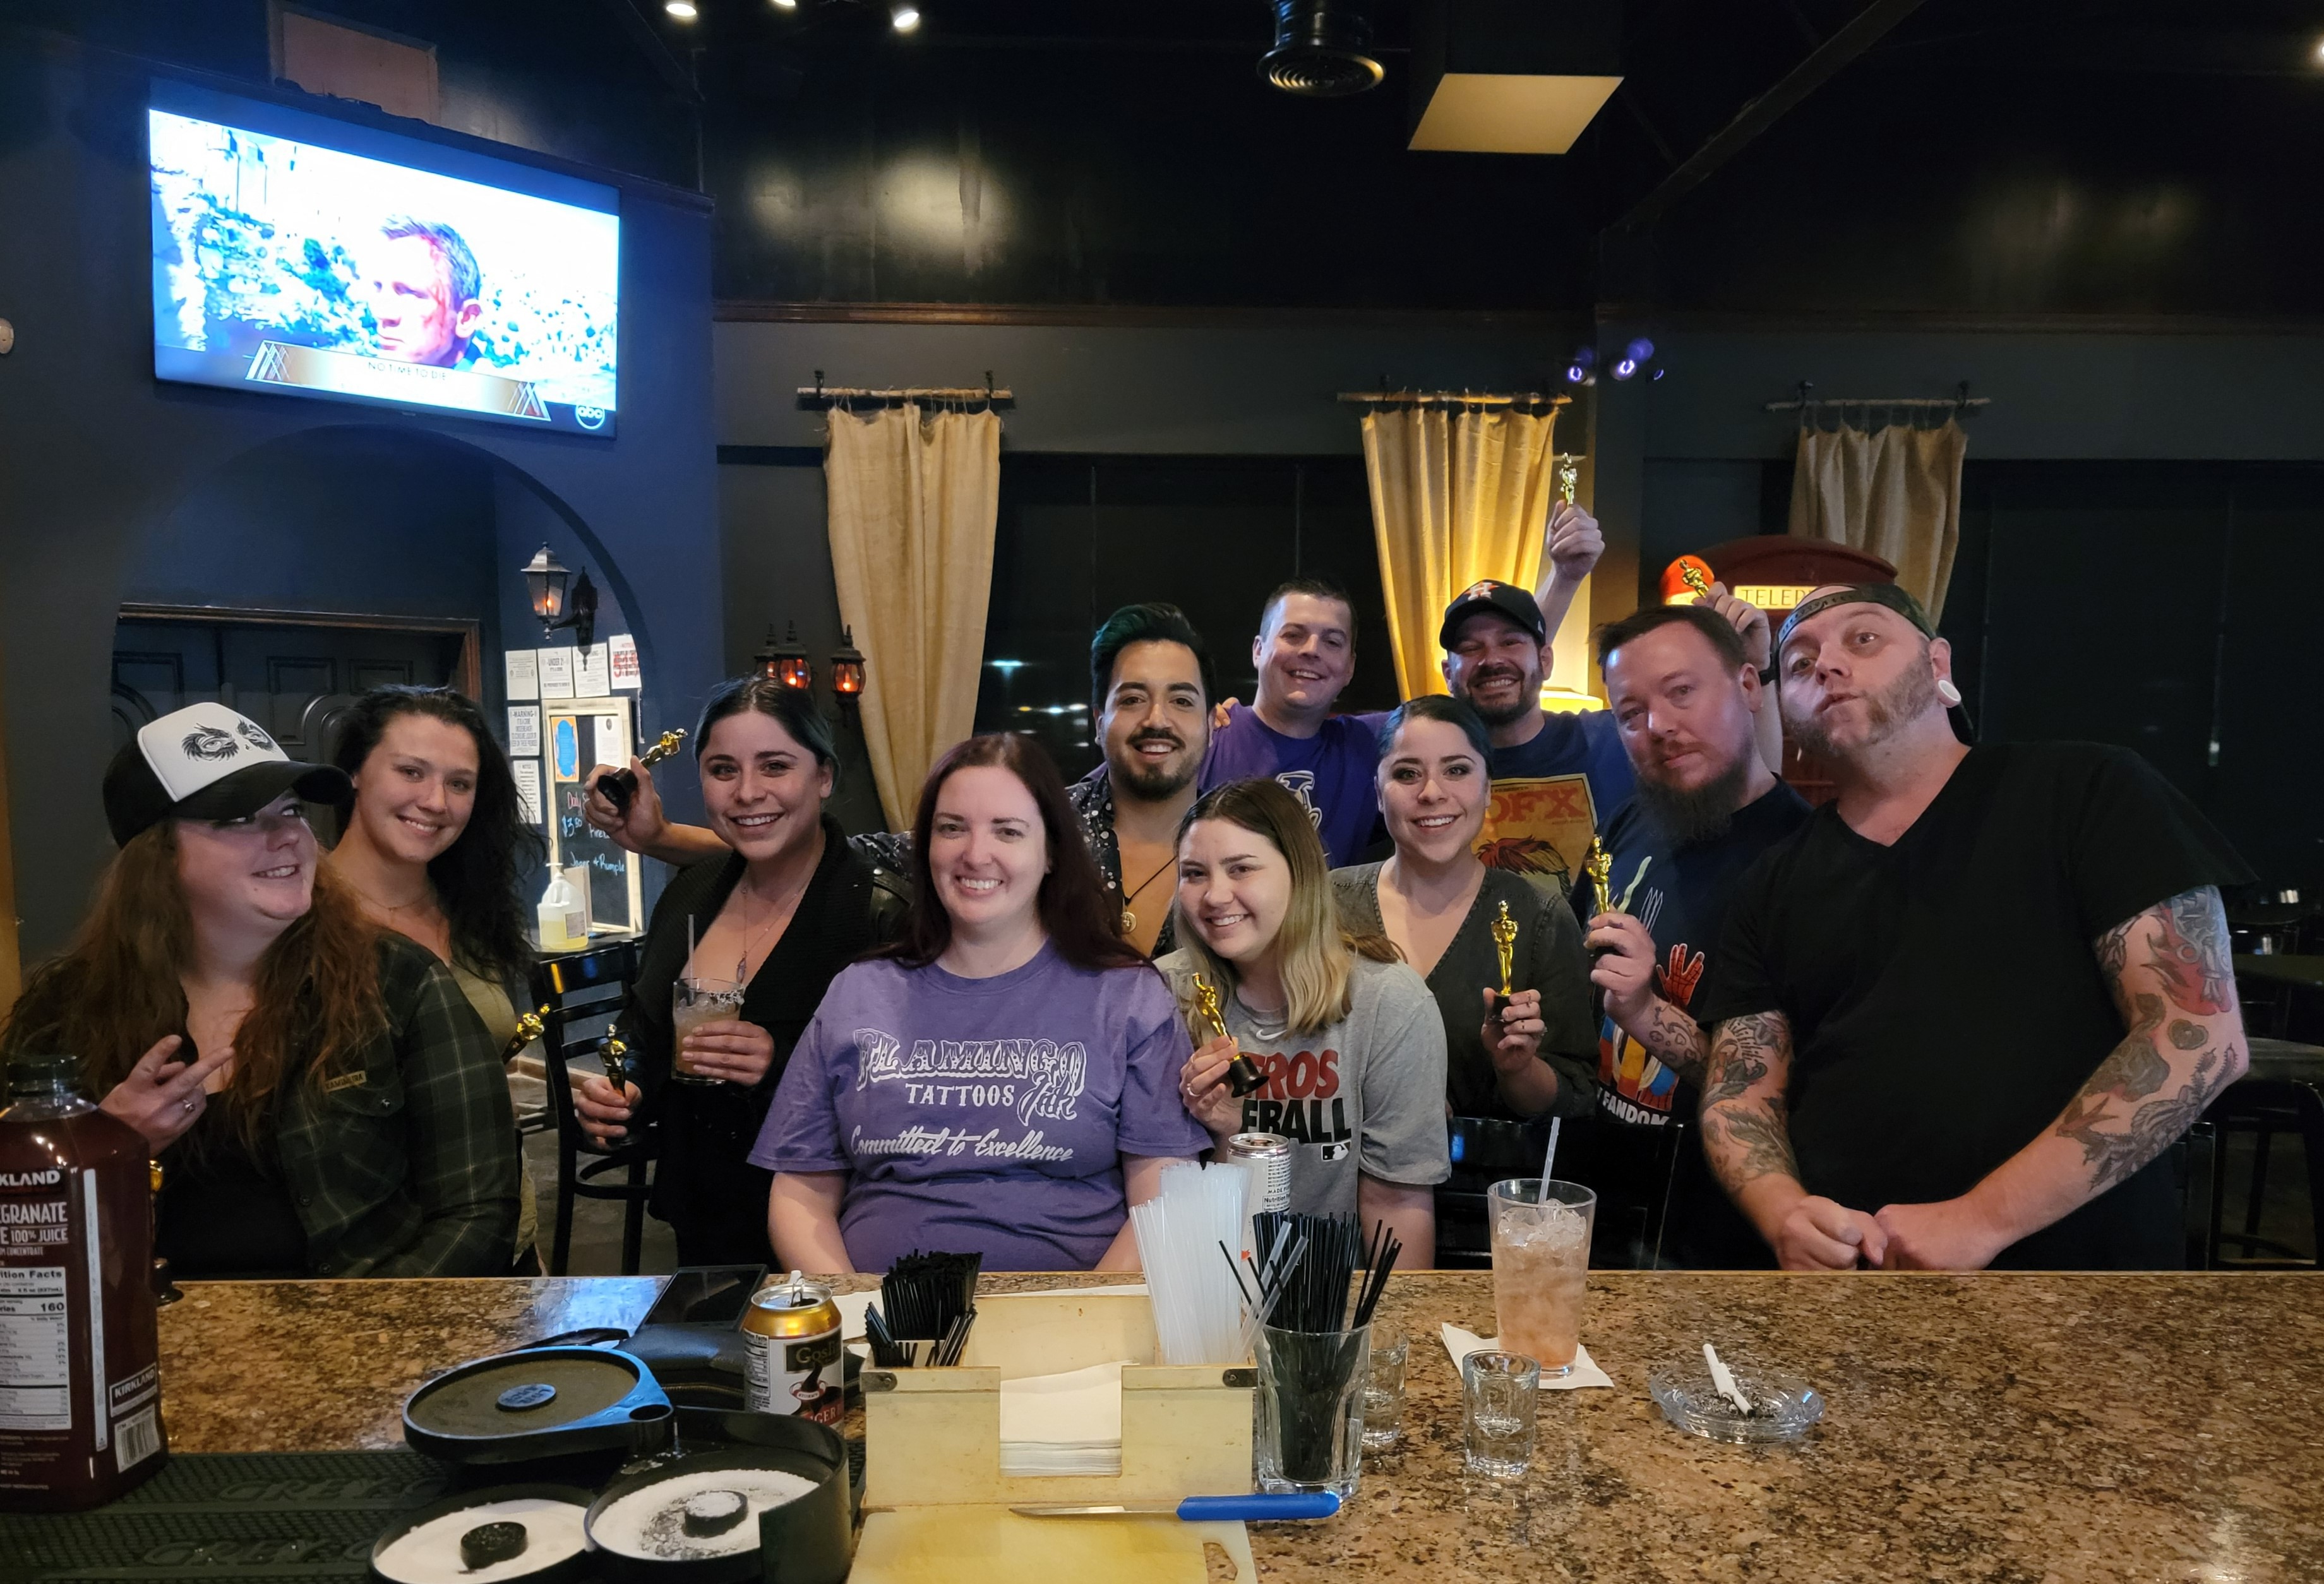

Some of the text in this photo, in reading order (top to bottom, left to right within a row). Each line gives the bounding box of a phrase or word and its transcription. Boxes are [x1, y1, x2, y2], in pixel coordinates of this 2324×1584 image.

[369, 362, 445, 380] NO TIME TO DIE
[577, 406, 603, 419] abc
[1741, 589, 1812, 606] TELEP
[853, 1028, 1087, 1097] FLAMINGO
[905, 1083, 1015, 1107] TATTOOS
[851, 1125, 950, 1156] Committed
[974, 1128, 1074, 1162] Excellence
[11, 1229, 37, 1243] 100%
[39, 1227, 68, 1242] JUICE
[29, 1270, 62, 1278] Facts
[40, 1302, 64, 1312] 160
[114, 1369, 155, 1398] KIRKLAND
